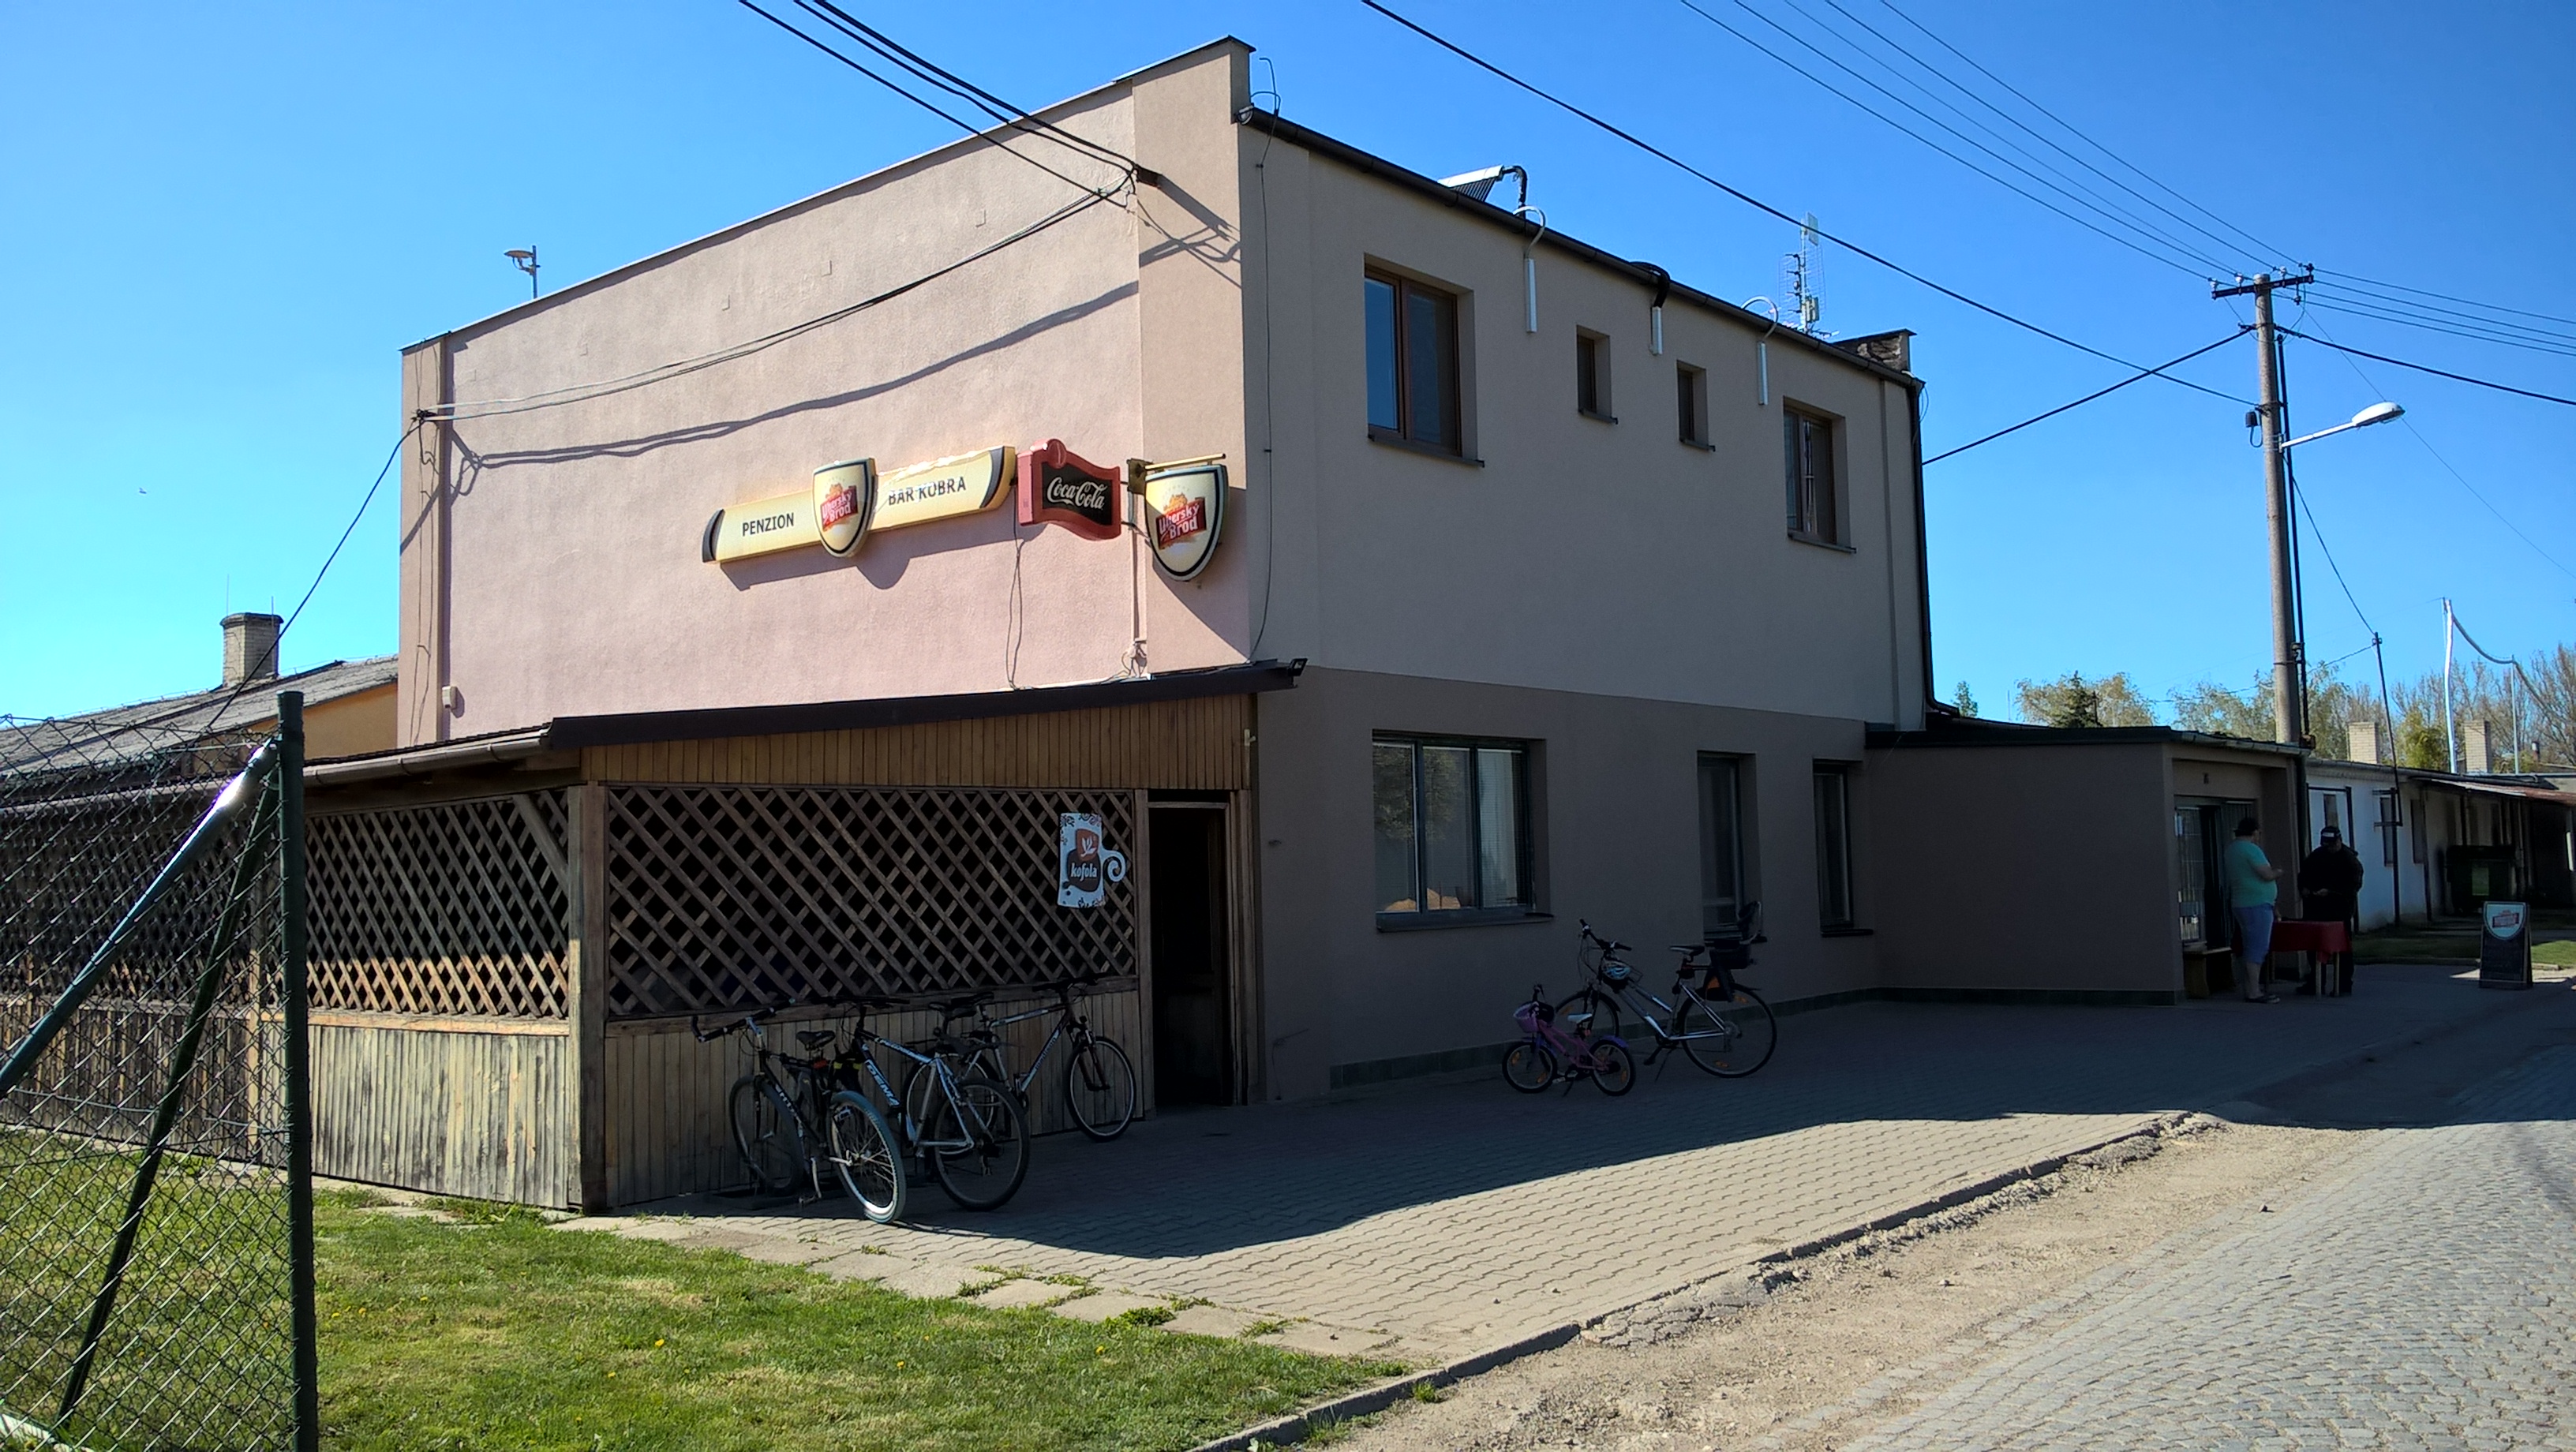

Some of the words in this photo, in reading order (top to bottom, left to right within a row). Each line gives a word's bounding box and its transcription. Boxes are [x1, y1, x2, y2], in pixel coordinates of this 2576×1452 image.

[888, 486, 915, 506] BAR
[918, 476, 967, 500] KOBRA
[743, 511, 794, 537] PENZION
[829, 501, 852, 522] Brod
[1168, 515, 1198, 540] Brod
[1070, 862, 1097, 881] kofola
